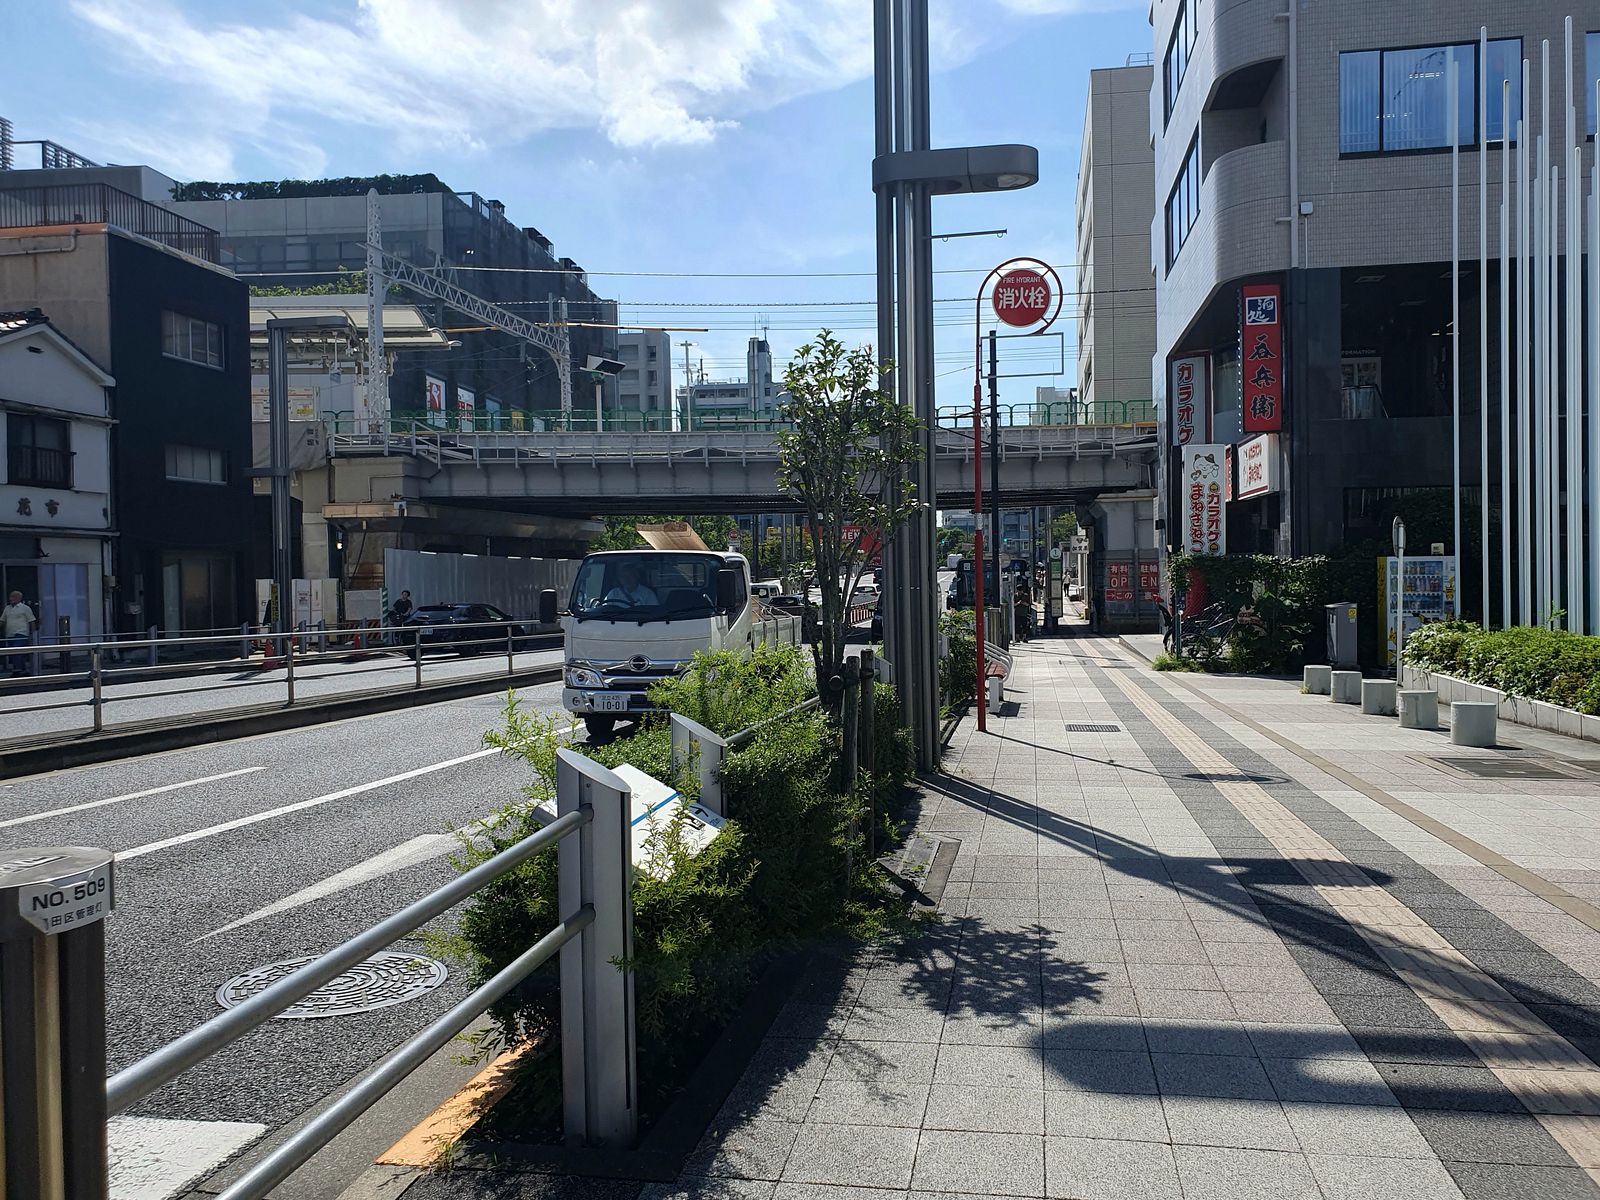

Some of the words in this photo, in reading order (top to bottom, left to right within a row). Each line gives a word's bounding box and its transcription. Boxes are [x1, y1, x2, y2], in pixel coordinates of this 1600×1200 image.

[998, 286, 1046, 309] 消火栓
[1248, 299, 1274, 322] 酒処
[1248, 333, 1277, 420] 呑兵衛
[1177, 362, 1195, 445] カラオケ
[1189, 481, 1205, 553] まねきねこ
[1206, 493, 1221, 542] カラオケ
[32, 892, 70, 911] NO.
[74, 877, 105, 901] 509
